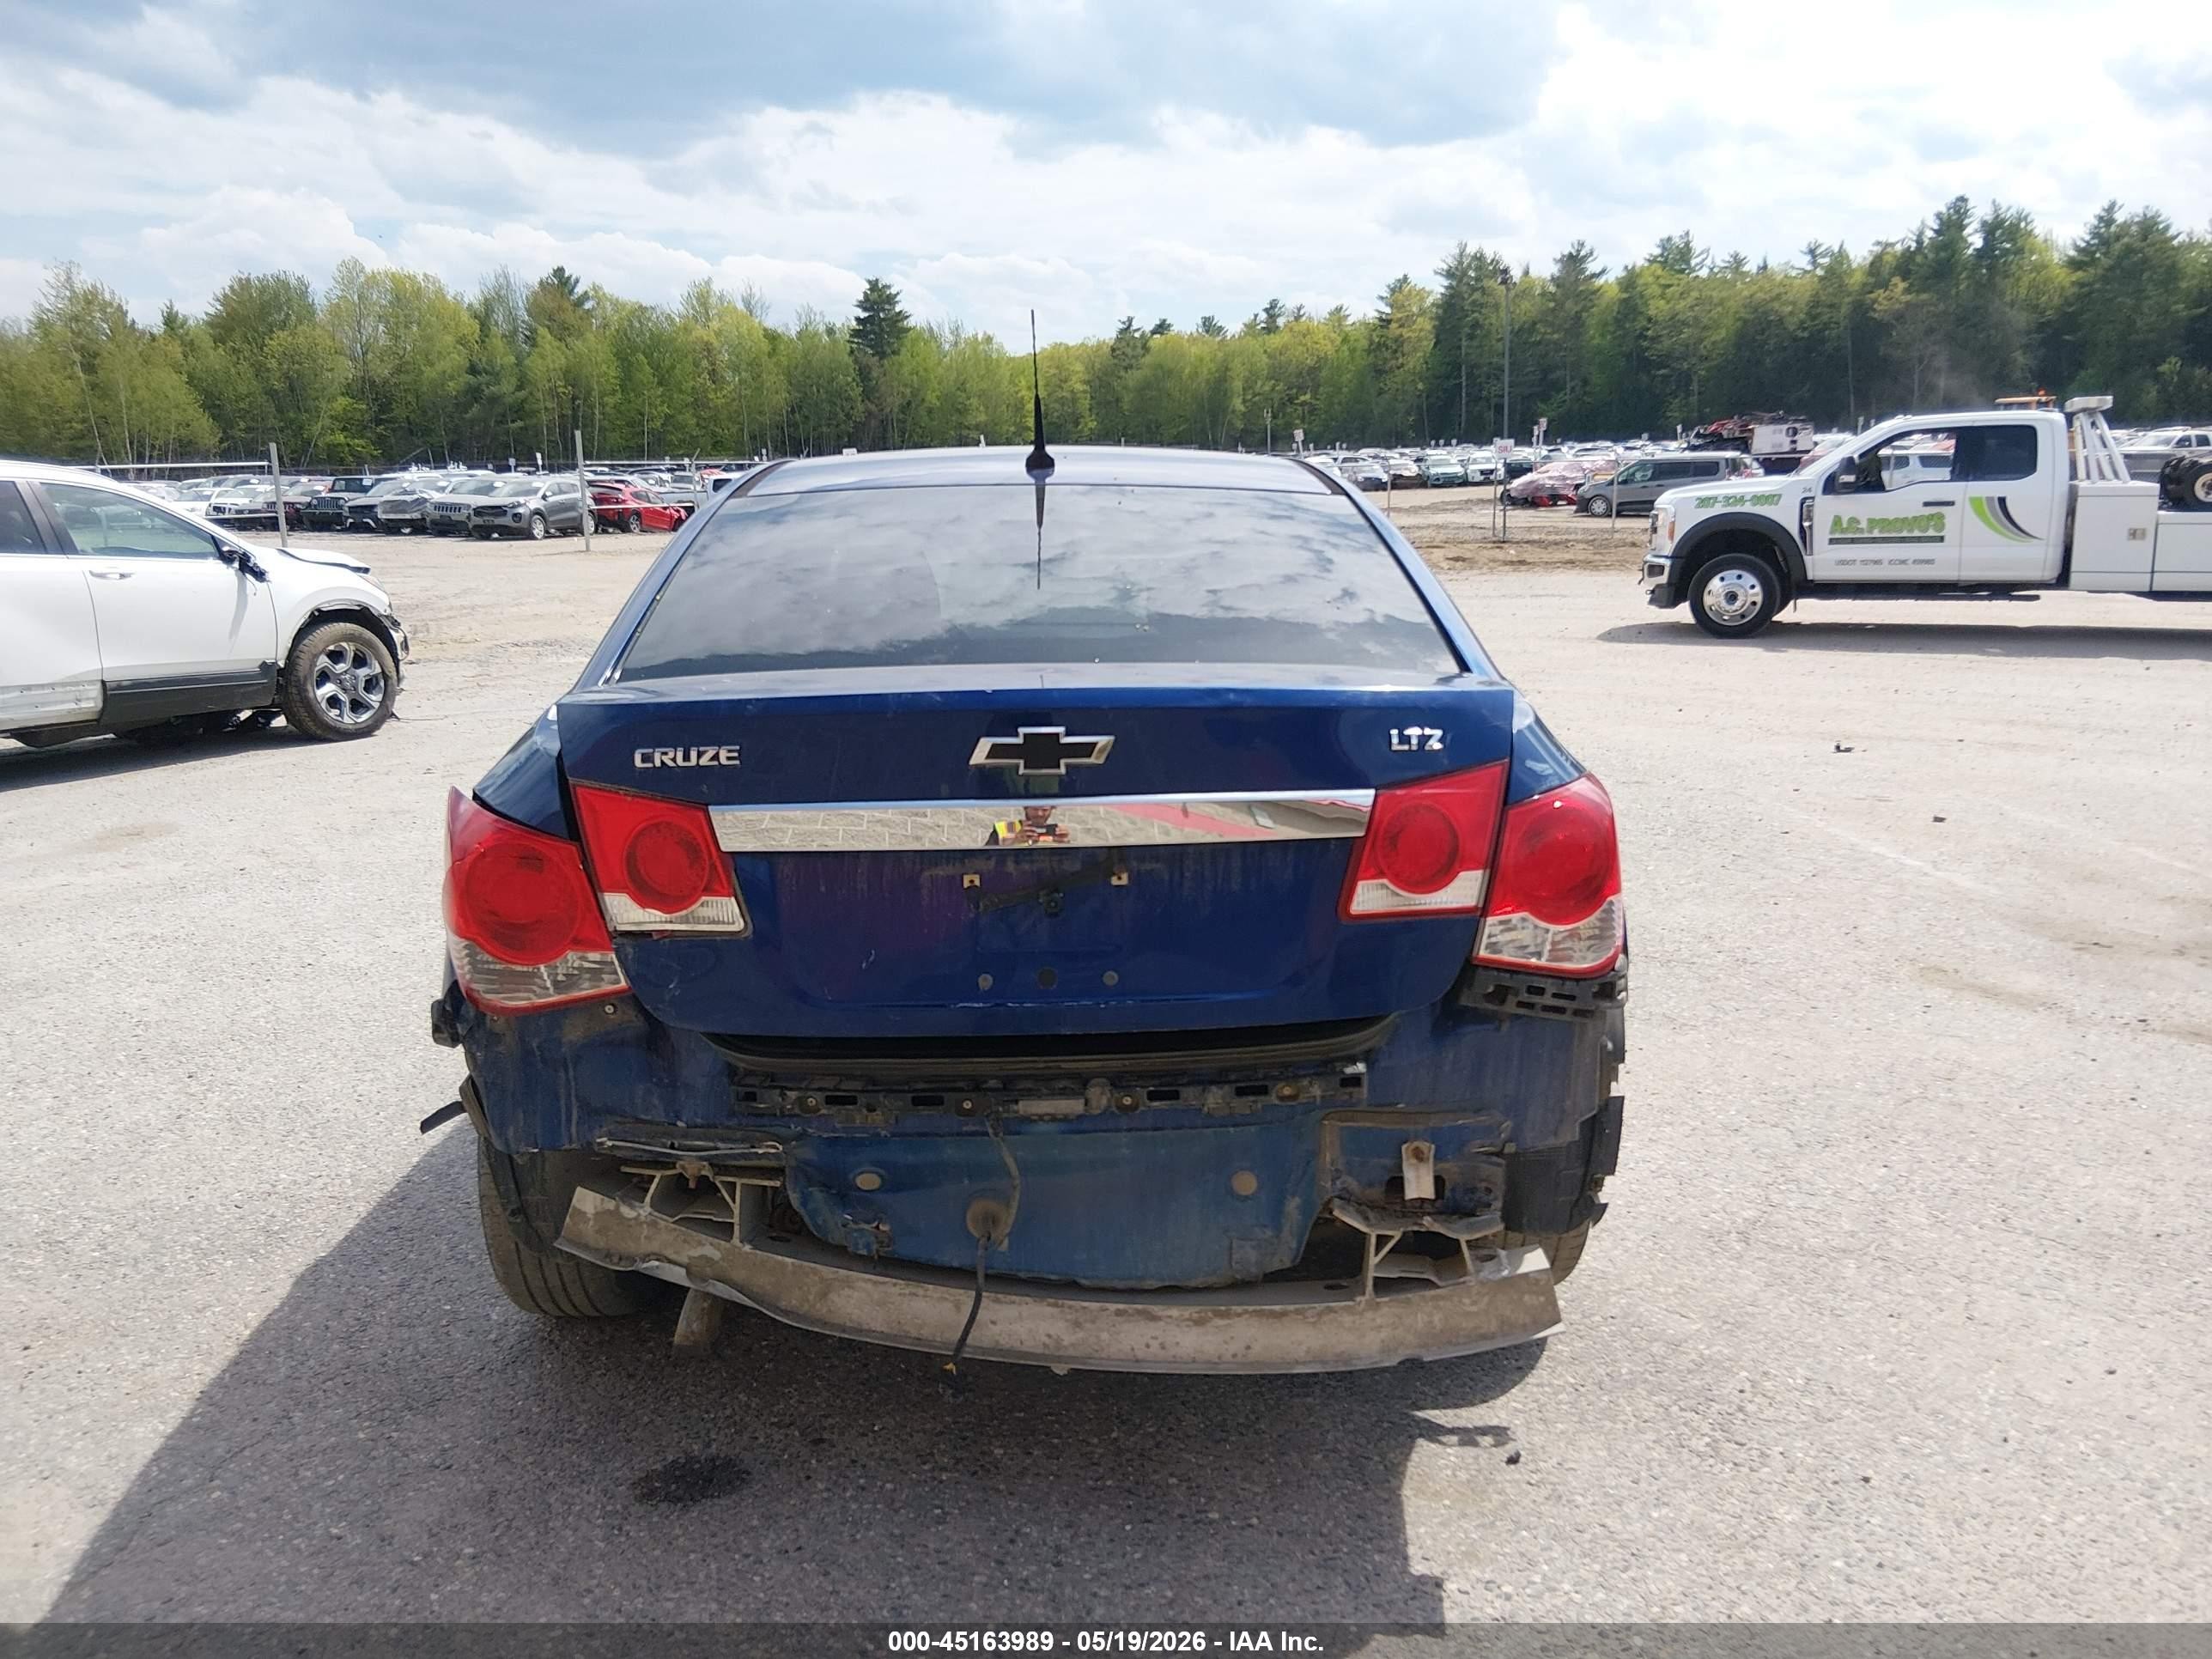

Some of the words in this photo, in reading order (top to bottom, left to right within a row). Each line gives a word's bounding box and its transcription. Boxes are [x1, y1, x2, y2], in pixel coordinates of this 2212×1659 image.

[1829, 514, 1865, 534] A.C.
[1867, 512, 1946, 534] PROVO'S
[1389, 726, 1443, 750] LTZ
[634, 745, 740, 768] CRUZE
